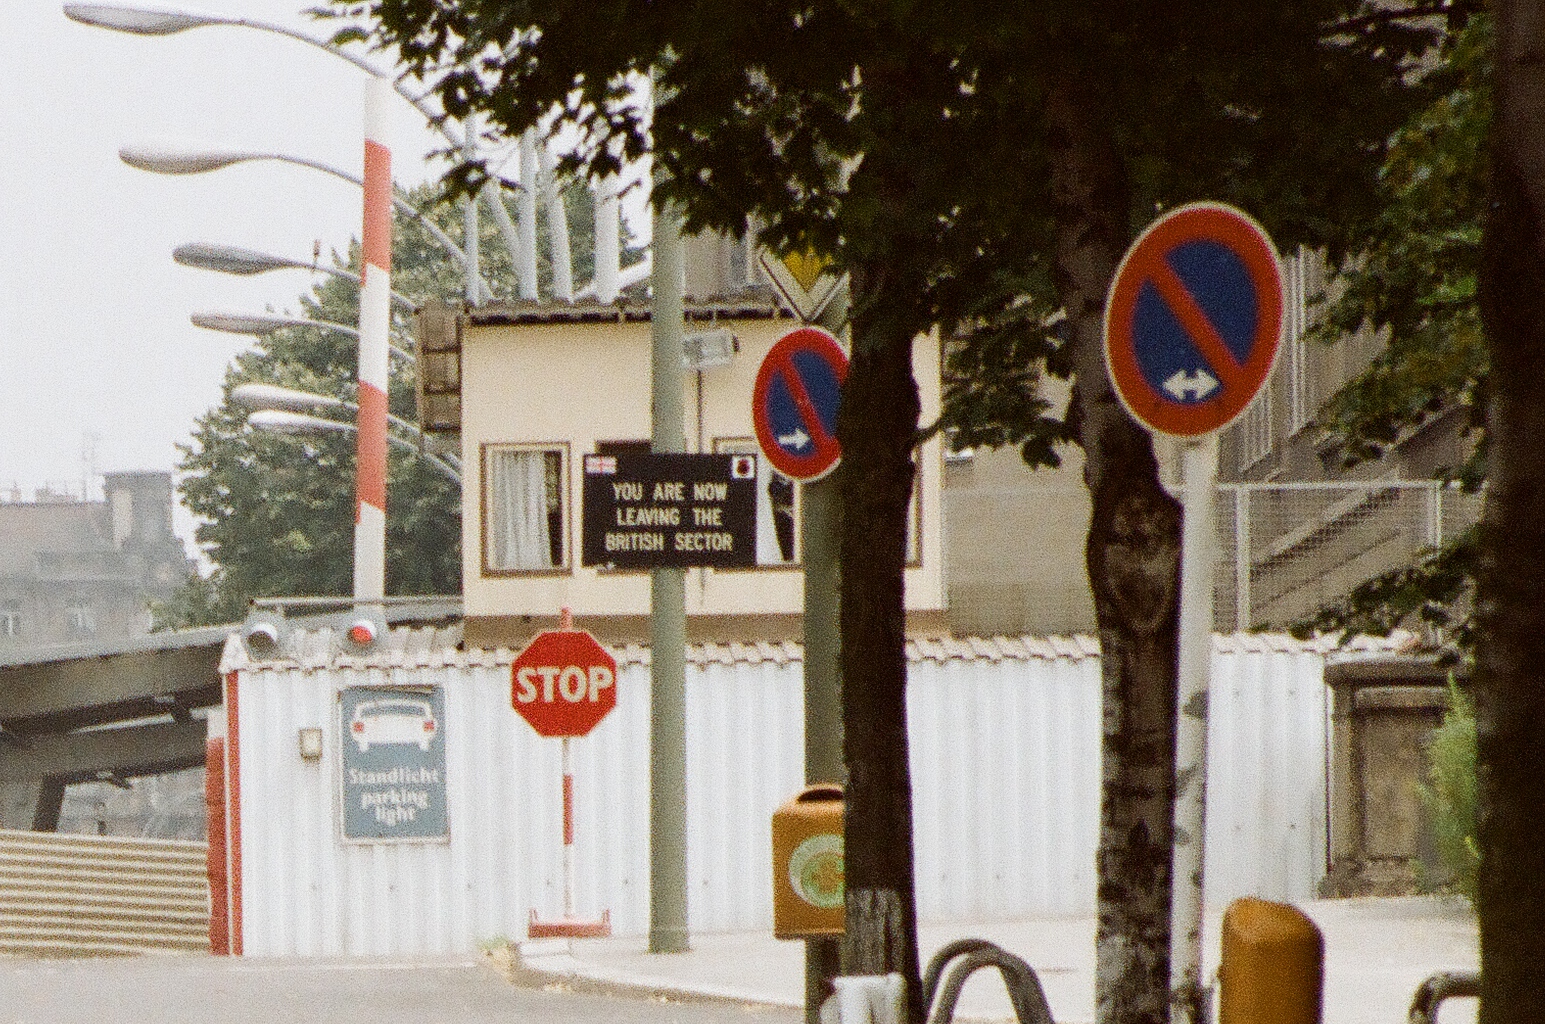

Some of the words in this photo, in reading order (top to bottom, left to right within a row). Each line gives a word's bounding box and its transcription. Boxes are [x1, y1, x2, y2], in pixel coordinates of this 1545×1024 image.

[612, 482, 643, 501] YOU
[654, 482, 685, 501] ARE
[694, 482, 727, 501] NOW
[616, 507, 680, 526] LEAVING
[694, 507, 723, 526] THE
[606, 532, 664, 551] BRITISH
[674, 532, 733, 551] SECTOR
[517, 665, 614, 703] STOP
[349, 766, 439, 784] Standlicht
[361, 787, 430, 810] parking
[376, 806, 417, 827] light
